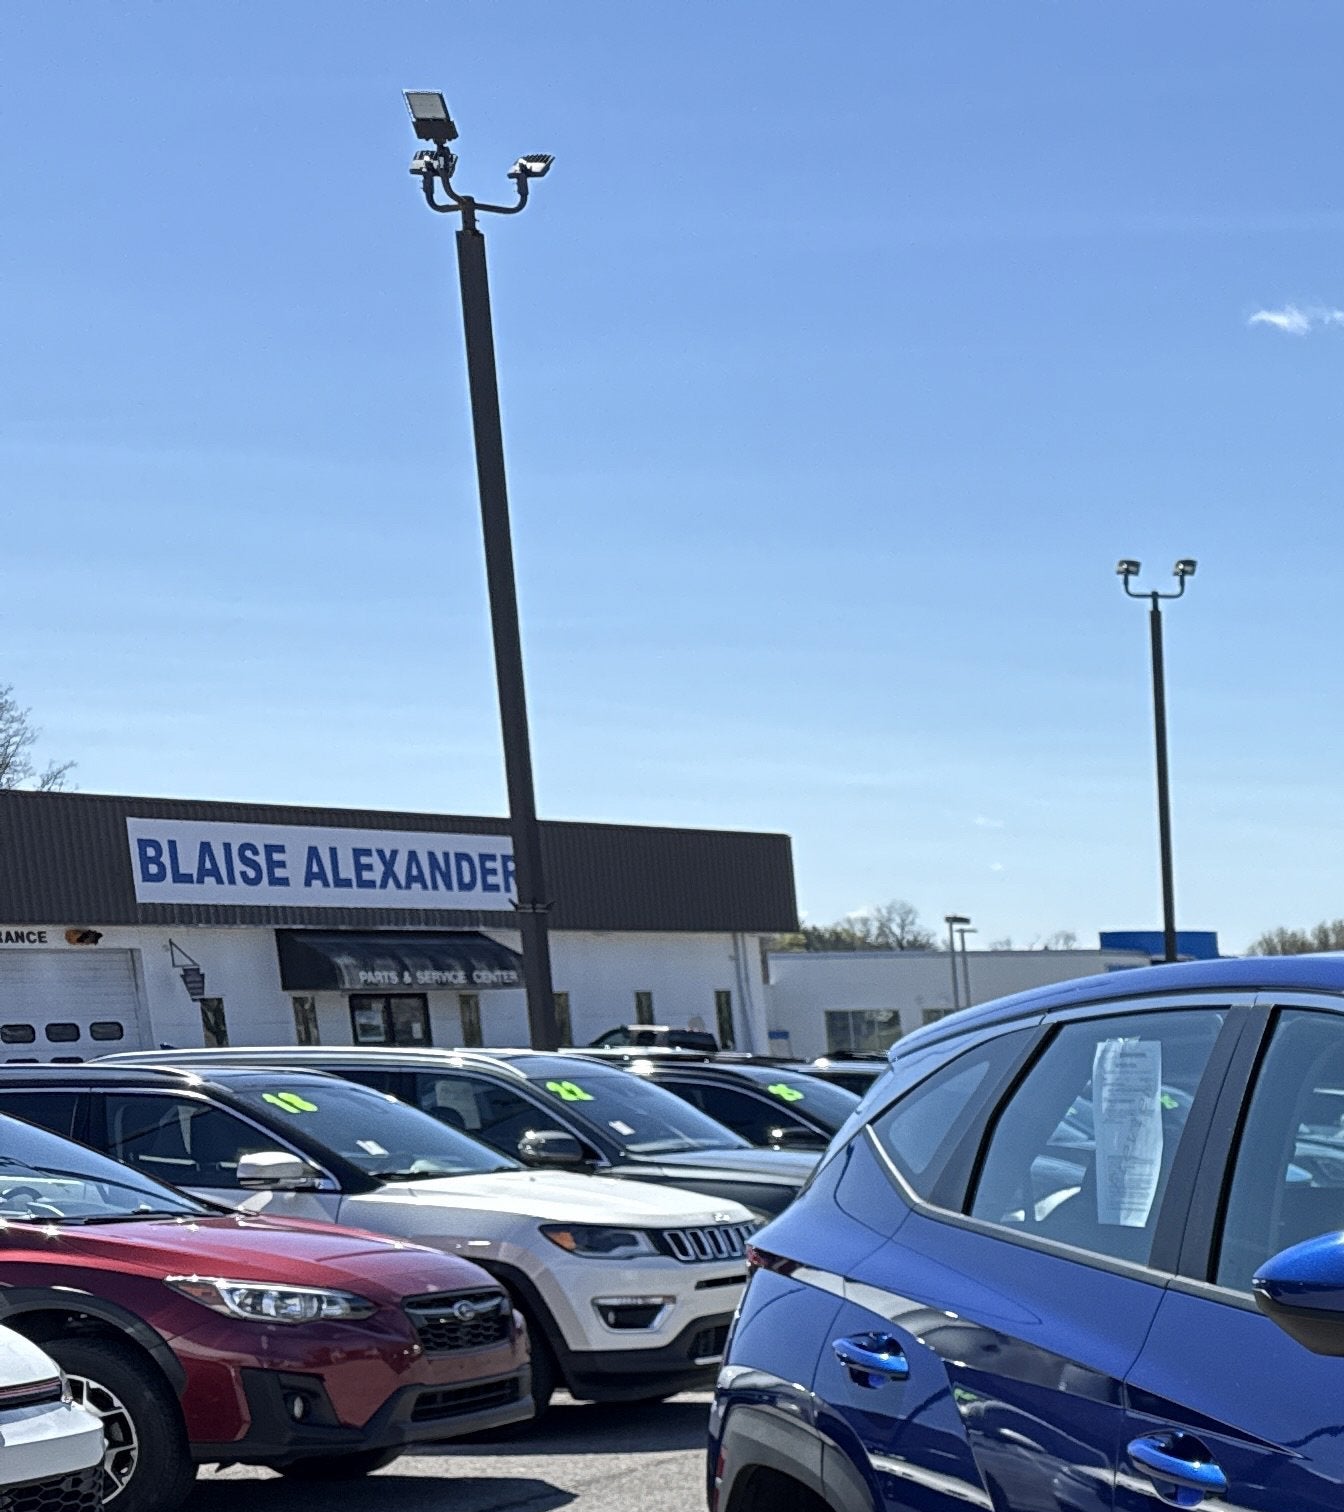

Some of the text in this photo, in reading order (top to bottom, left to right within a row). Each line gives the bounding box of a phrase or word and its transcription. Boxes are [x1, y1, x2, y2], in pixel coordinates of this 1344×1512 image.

[136, 837, 291, 888] BLAISE
[358, 970, 519, 984] PARTS & SERVICE CENTER
